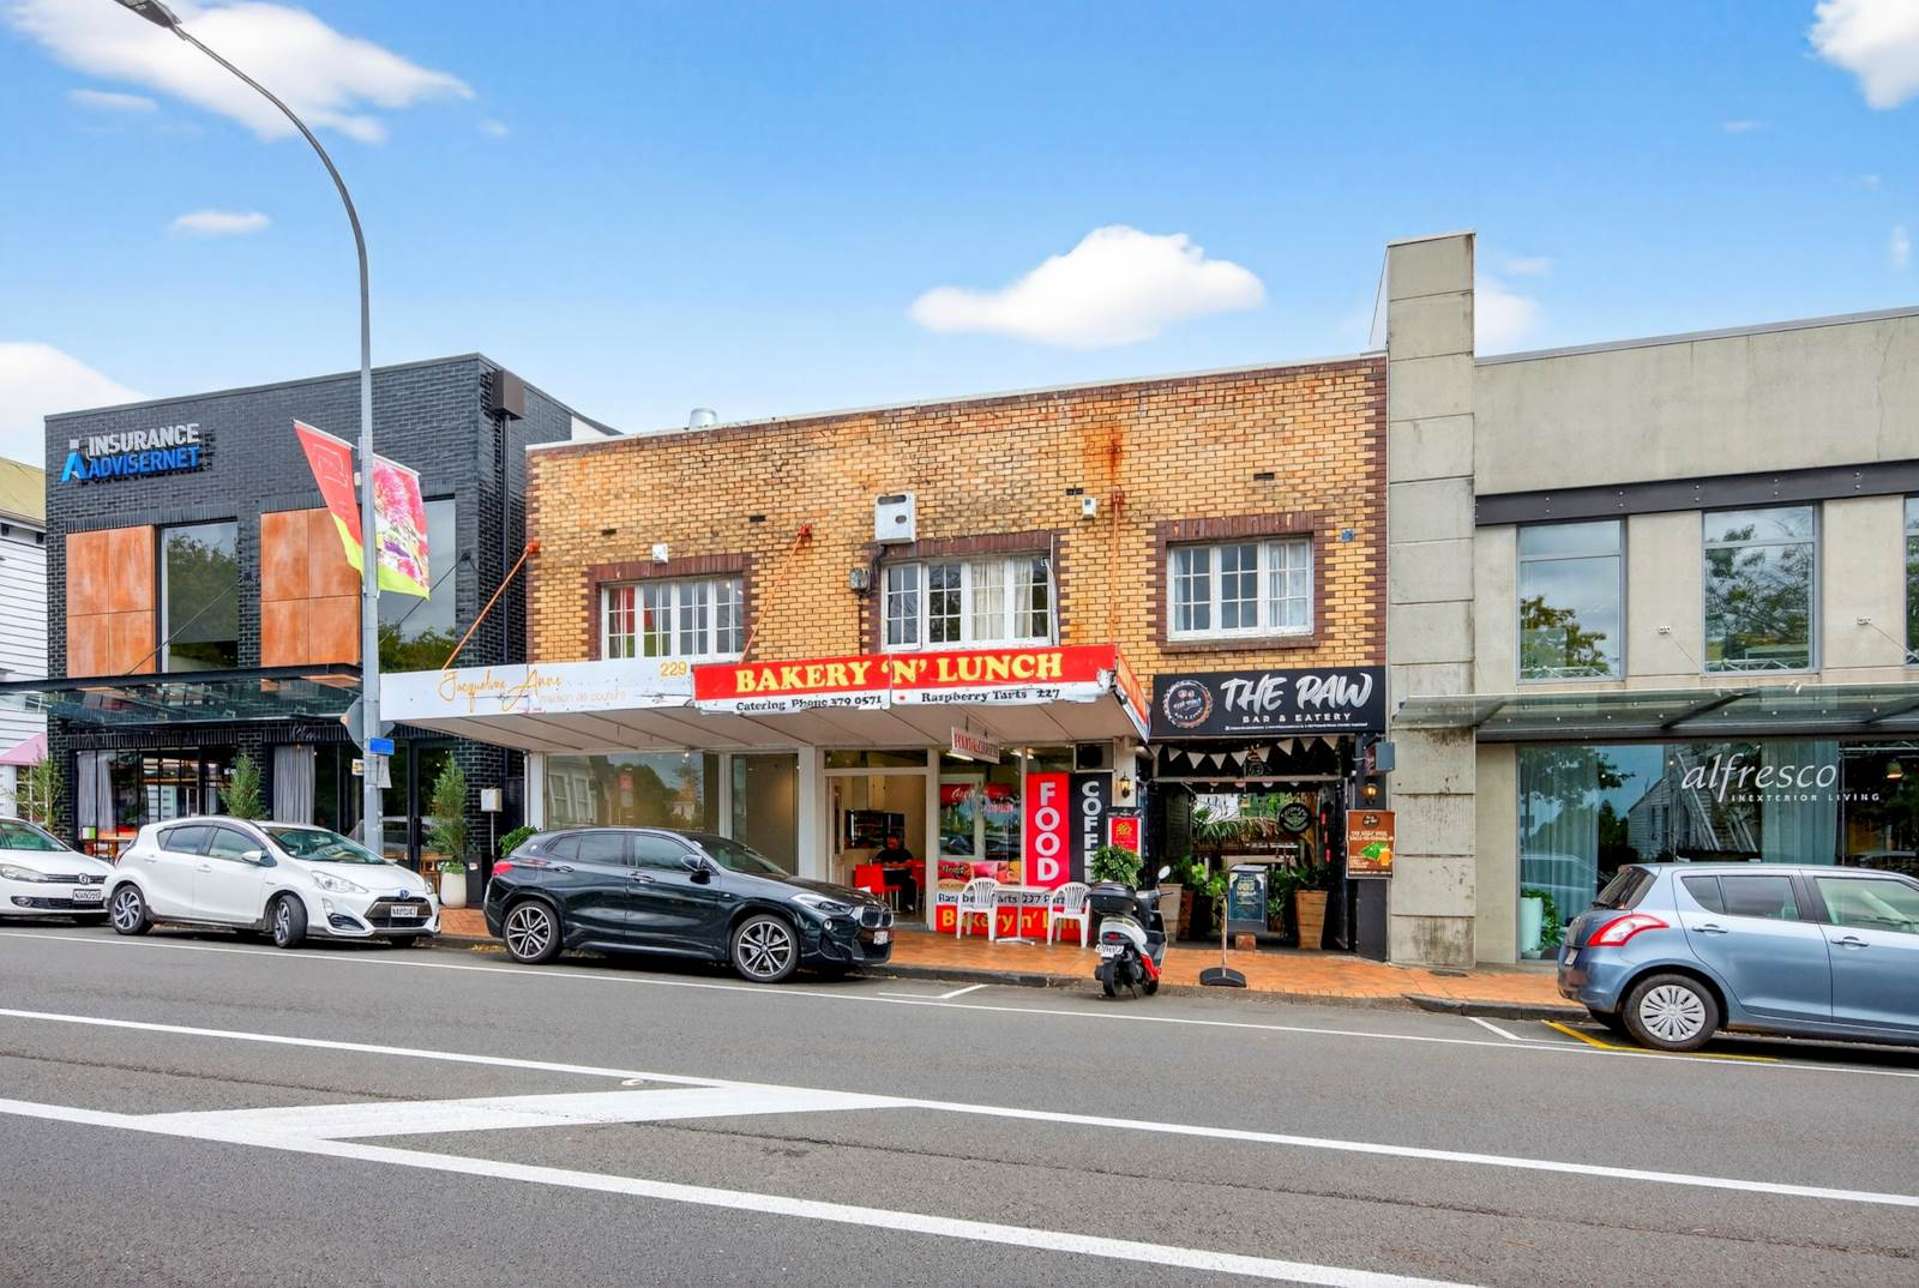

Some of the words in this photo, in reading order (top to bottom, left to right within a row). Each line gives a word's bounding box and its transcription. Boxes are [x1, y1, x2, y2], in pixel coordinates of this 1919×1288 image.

[88, 423, 201, 456] INSURANCE
[88, 446, 200, 478] ADVISERNET
[660, 661, 687, 679] 229
[734, 660, 872, 693] BAKERY
[936, 652, 1063, 683] LUNCH
[736, 700, 786, 712] Catering
[791, 698, 828, 709] Phone
[921, 691, 990, 703] Raspberry
[992, 689, 1027, 700] Tarts
[1036, 688, 1060, 699] 227
[1220, 673, 1287, 715] THE
[1242, 715, 1270, 724] BAR
[1295, 712, 1352, 723] EATERY
[1681, 752, 1837, 803] alfresco
[1828, 792, 1880, 802] LIVING
[1035, 781, 1060, 881] FOOD
